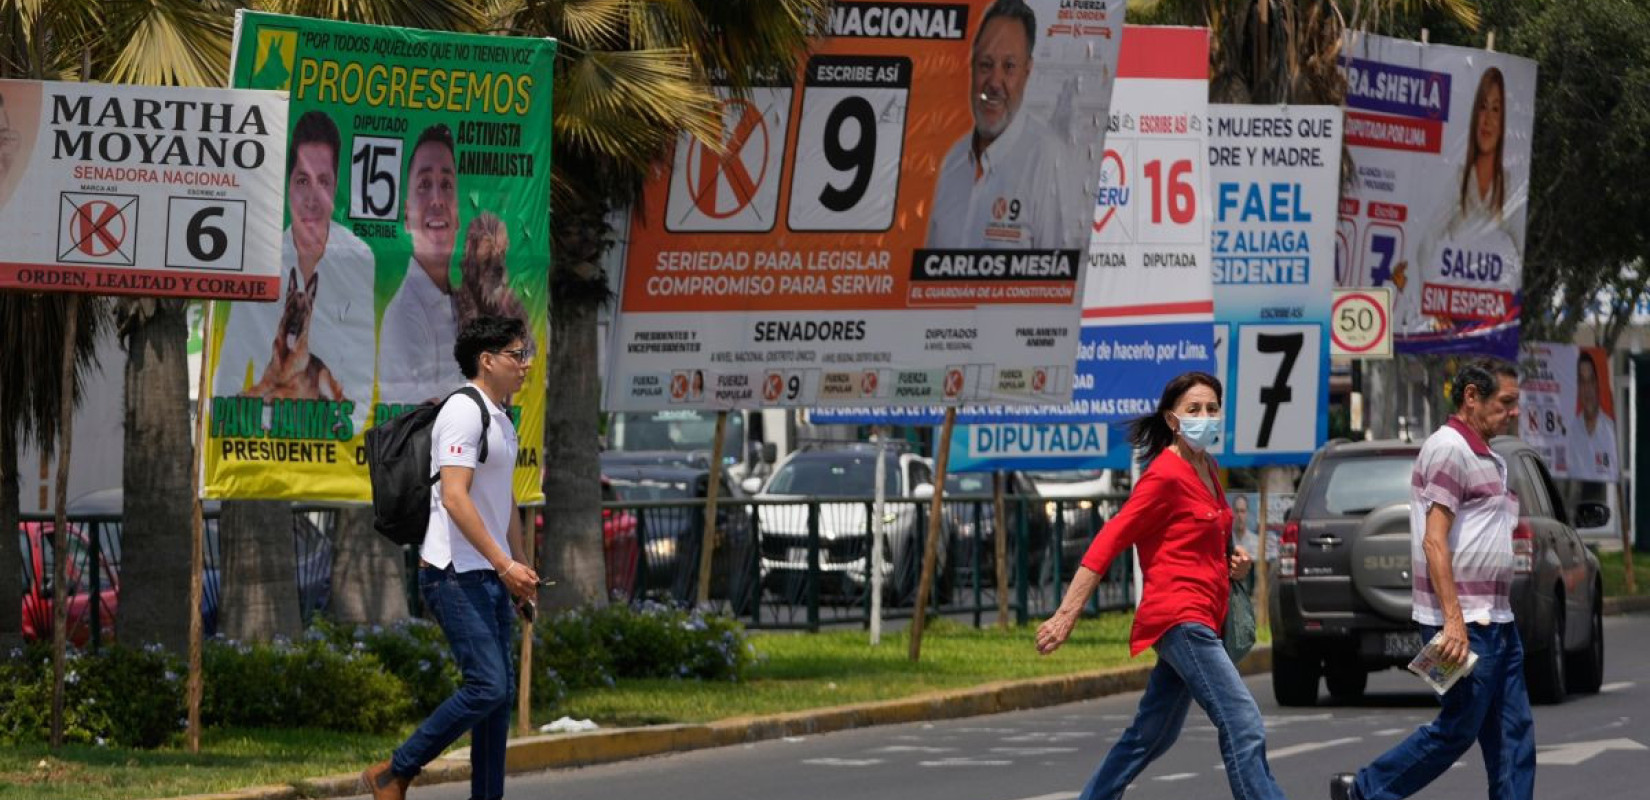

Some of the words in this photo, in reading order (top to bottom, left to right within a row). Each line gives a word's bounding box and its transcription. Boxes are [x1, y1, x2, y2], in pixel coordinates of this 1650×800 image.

[826, 5, 962, 39] NACIONAL
[333, 34, 370, 52] TODOS
[373, 37, 428, 58] AQUELLOS
[430, 42, 452, 61] QUE
[454, 43, 470, 59] NO
[472, 44, 510, 63] TIENEN
[817, 65, 873, 81] ESCRIBE
[875, 63, 900, 81] ASÍ
[297, 57, 534, 116] PROGRESEMOS
[50, 94, 270, 136] MARTHA
[353, 114, 408, 133] DIPUTADO
[1139, 115, 1172, 134] ESCRIBE
[457, 120, 523, 148] ACTIVISTA
[1218, 119, 1292, 138] MUJERES
[1297, 119, 1332, 139] QUE
[1388, 124, 1404, 143] POR
[1405, 126, 1427, 146] LIMA
[51, 129, 266, 169] MOYANO
[818, 95, 877, 213] 9
[1209, 147, 1241, 166] DRE
[1246, 147, 1257, 166] Y
[1262, 147, 1324, 167] MADRE.
[457, 149, 534, 178] ANIMALISTA
[73, 166, 159, 184] SENADORA
[162, 169, 240, 188] NACIONAL
[80, 184, 105, 192] MARCA
[352, 143, 398, 217] 15
[1098, 187, 1129, 206] ERU
[1143, 159, 1197, 225] 16
[1217, 183, 1312, 223] FAEL
[1008, 198, 1021, 221] 9
[74, 201, 124, 257] K
[186, 206, 228, 262] 6
[352, 222, 398, 239] ESCRIBE
[1233, 230, 1310, 254] ALIAGA
[656, 251, 750, 271] SERIEDAD
[754, 251, 803, 271] PARA
[807, 250, 891, 271] LEGISLAR
[924, 254, 1006, 277] CARLOS
[1010, 250, 1071, 276] MESÍA
[1143, 253, 1197, 268] DIPUTADA
[1213, 258, 1306, 283] SIDENTE
[1370, 234, 1395, 286] 7
[1441, 248, 1503, 283] SALUD
[17, 268, 91, 289] ORDEN,
[96, 272, 177, 291] LEALTAD
[181, 276, 196, 292] Y
[196, 278, 268, 297] CORAJE
[647, 276, 775, 297] COMPROMISO
[779, 276, 827, 295] PARA
[831, 275, 894, 295] SERVIR
[911, 288, 923, 299] EL
[924, 285, 976, 299] GUARDIÁN
[977, 287, 990, 299] DE
[991, 287, 1004, 298] LA
[1006, 285, 1072, 298] CONSTITUCIÓN
[1422, 287, 1448, 313] SIN
[1452, 291, 1506, 317] ESPERA
[754, 320, 866, 342] SENADORES
[1340, 307, 1374, 332] 50
[925, 328, 978, 340] DIPUTADOS
[1097, 340, 1112, 360] de
[1113, 339, 1155, 360] hacerlo
[1156, 344, 1177, 365] por
[1179, 340, 1209, 360] Lima.
[717, 375, 748, 387] FUERZA
[787, 375, 800, 400] 9
[898, 373, 928, 384] FUERZA
[1256, 332, 1304, 449] 7
[715, 390, 753, 400] POPULAR
[895, 386, 931, 397] POPULAR
[1090, 399, 1115, 414] MAS
[1117, 398, 1151, 414] CERCA
[211, 395, 264, 438] PAUL
[268, 397, 356, 442] JAIMES
[1545, 411, 1555, 433] 8
[976, 424, 1102, 454] DIPUTADA
[222, 440, 337, 464] PRESIDENTE
[1364, 555, 1409, 570] SUZ
